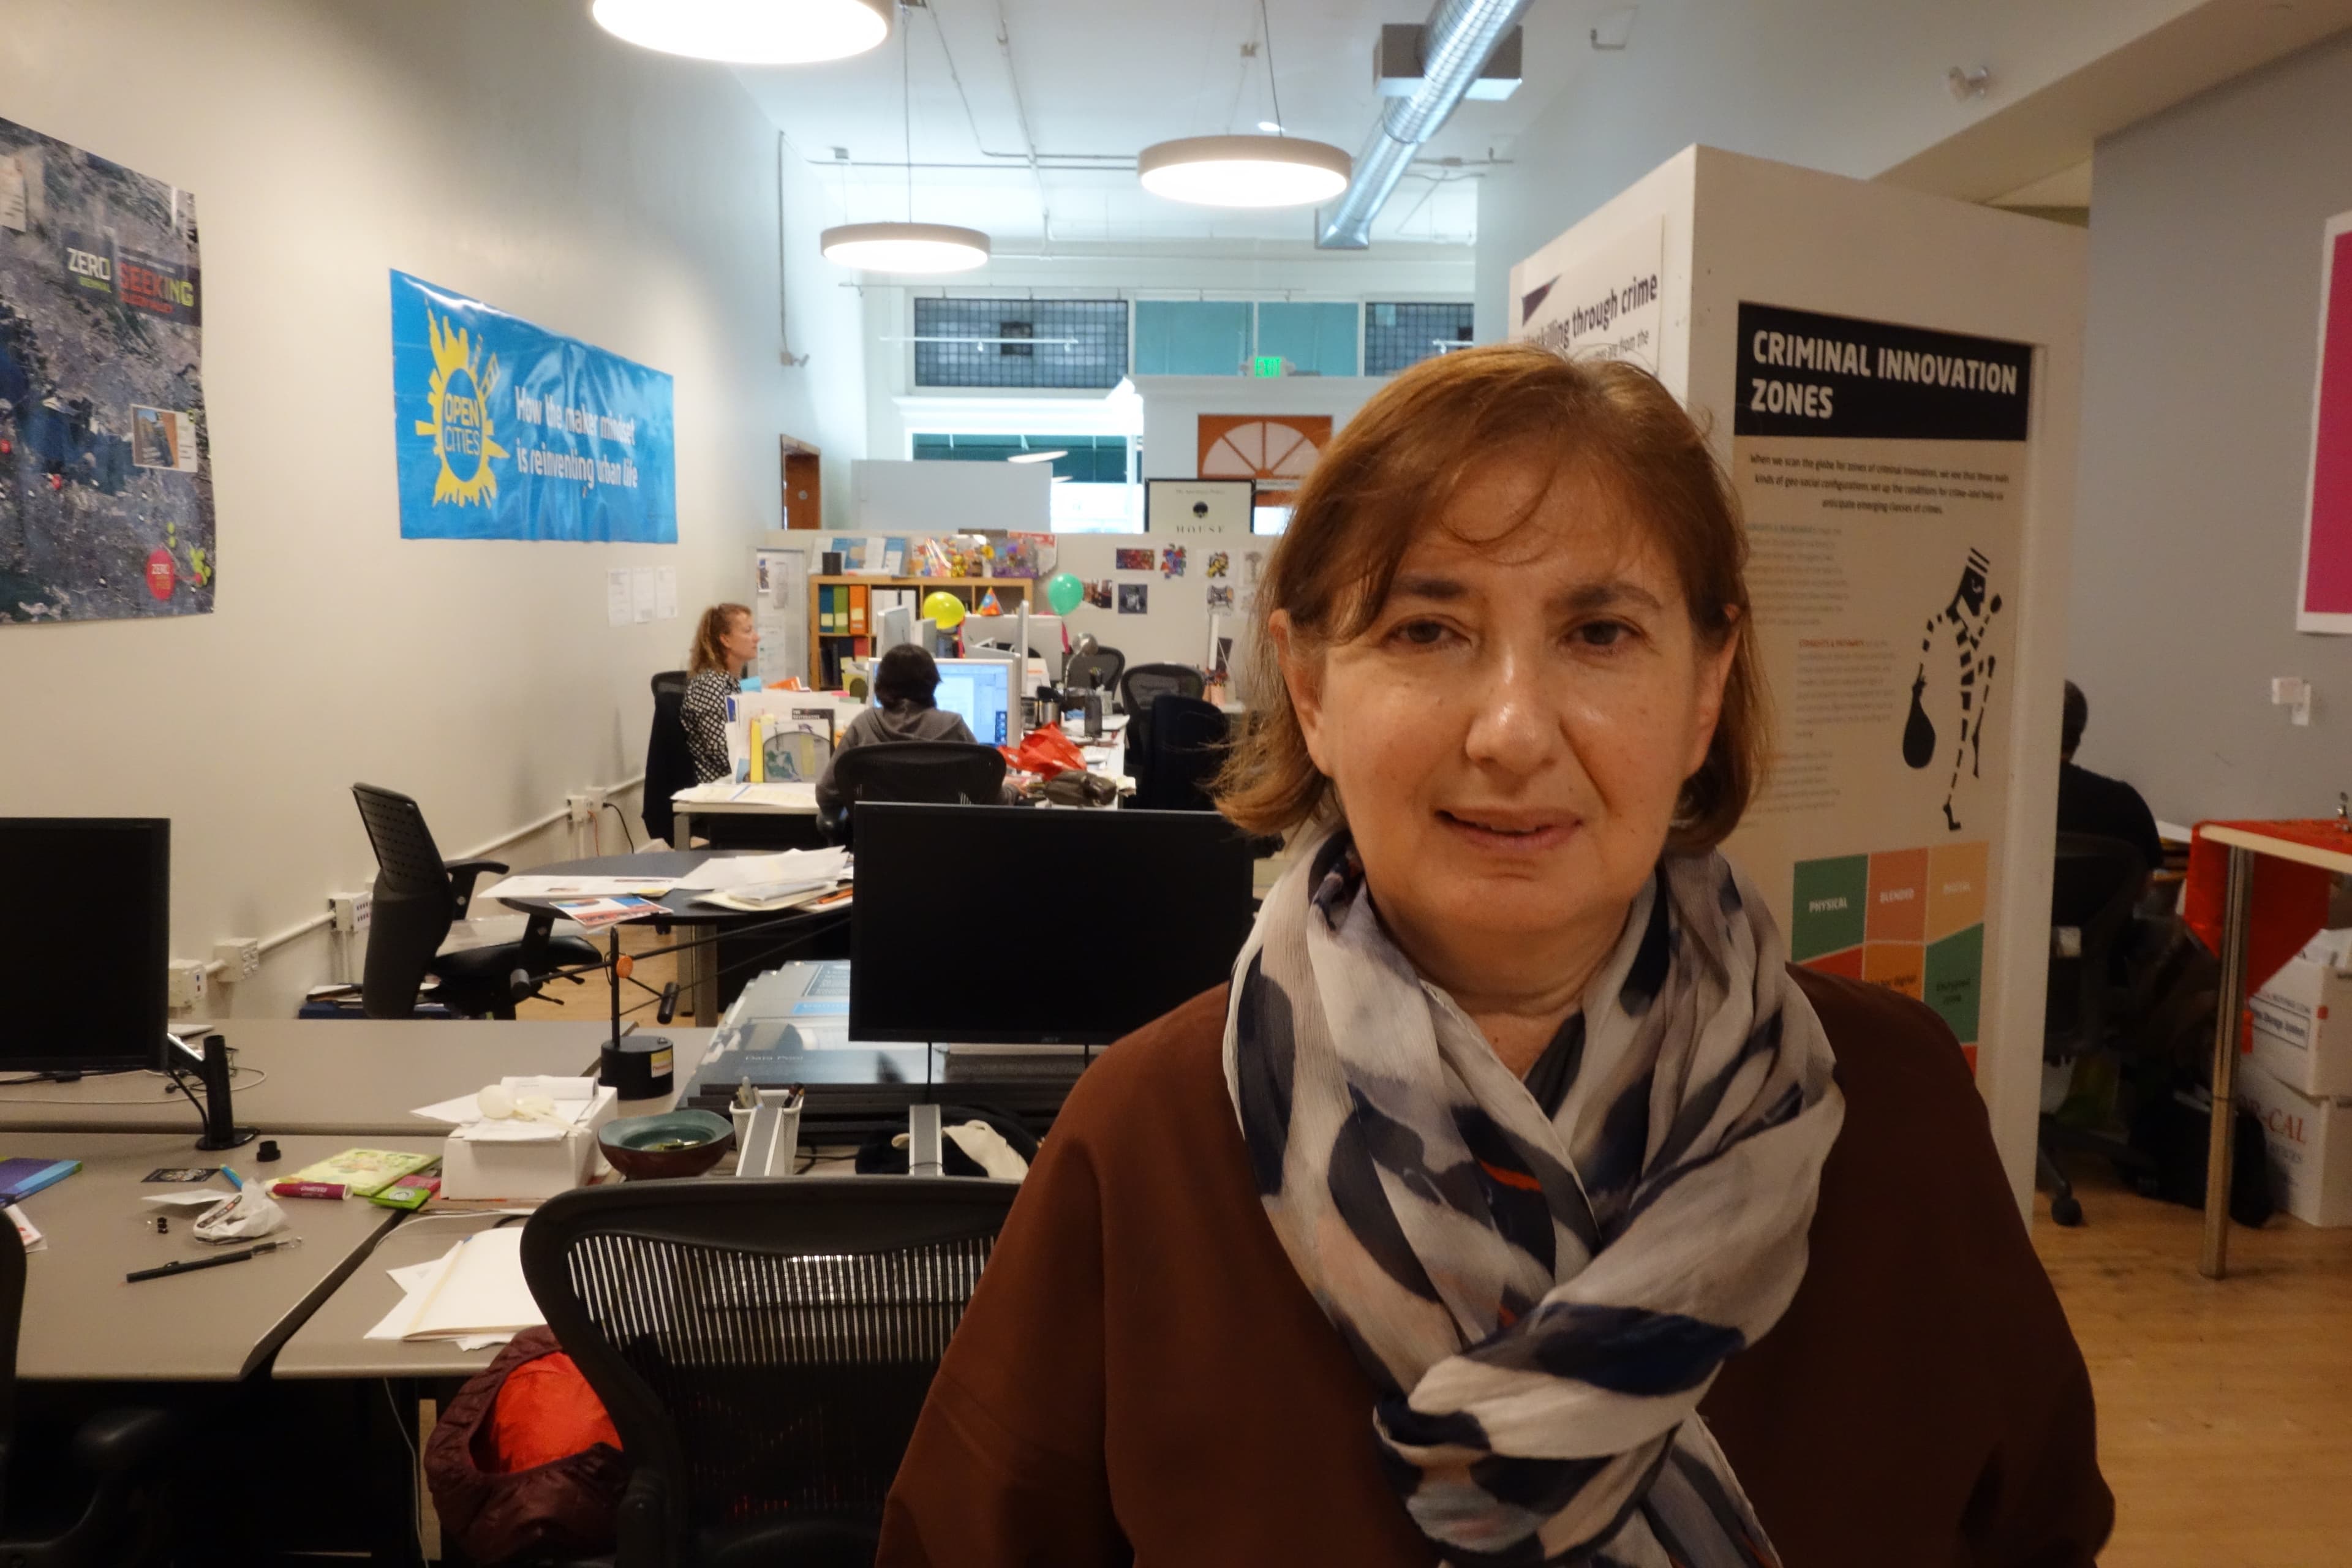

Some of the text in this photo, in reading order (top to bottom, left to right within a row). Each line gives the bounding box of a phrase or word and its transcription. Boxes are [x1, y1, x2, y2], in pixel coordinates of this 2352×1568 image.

[119, 262, 194, 306] SEEKING
[1573, 287, 1618, 338] through
[1622, 274, 1657, 314] crime
[1254, 356, 1281, 378] EXIT
[1753, 330, 2018, 395] CRIMINAL INNOVATION
[444, 393, 480, 428] OPEN
[514, 385, 635, 445] How the maker mindset
[1751, 378, 1833, 419] ZONES
[445, 425, 480, 455] CITIES
[516, 437, 638, 489] is reinventing urban life
[1176, 526, 1225, 534] HOUSE
[1809, 897, 1848, 913] PHYSICAL
